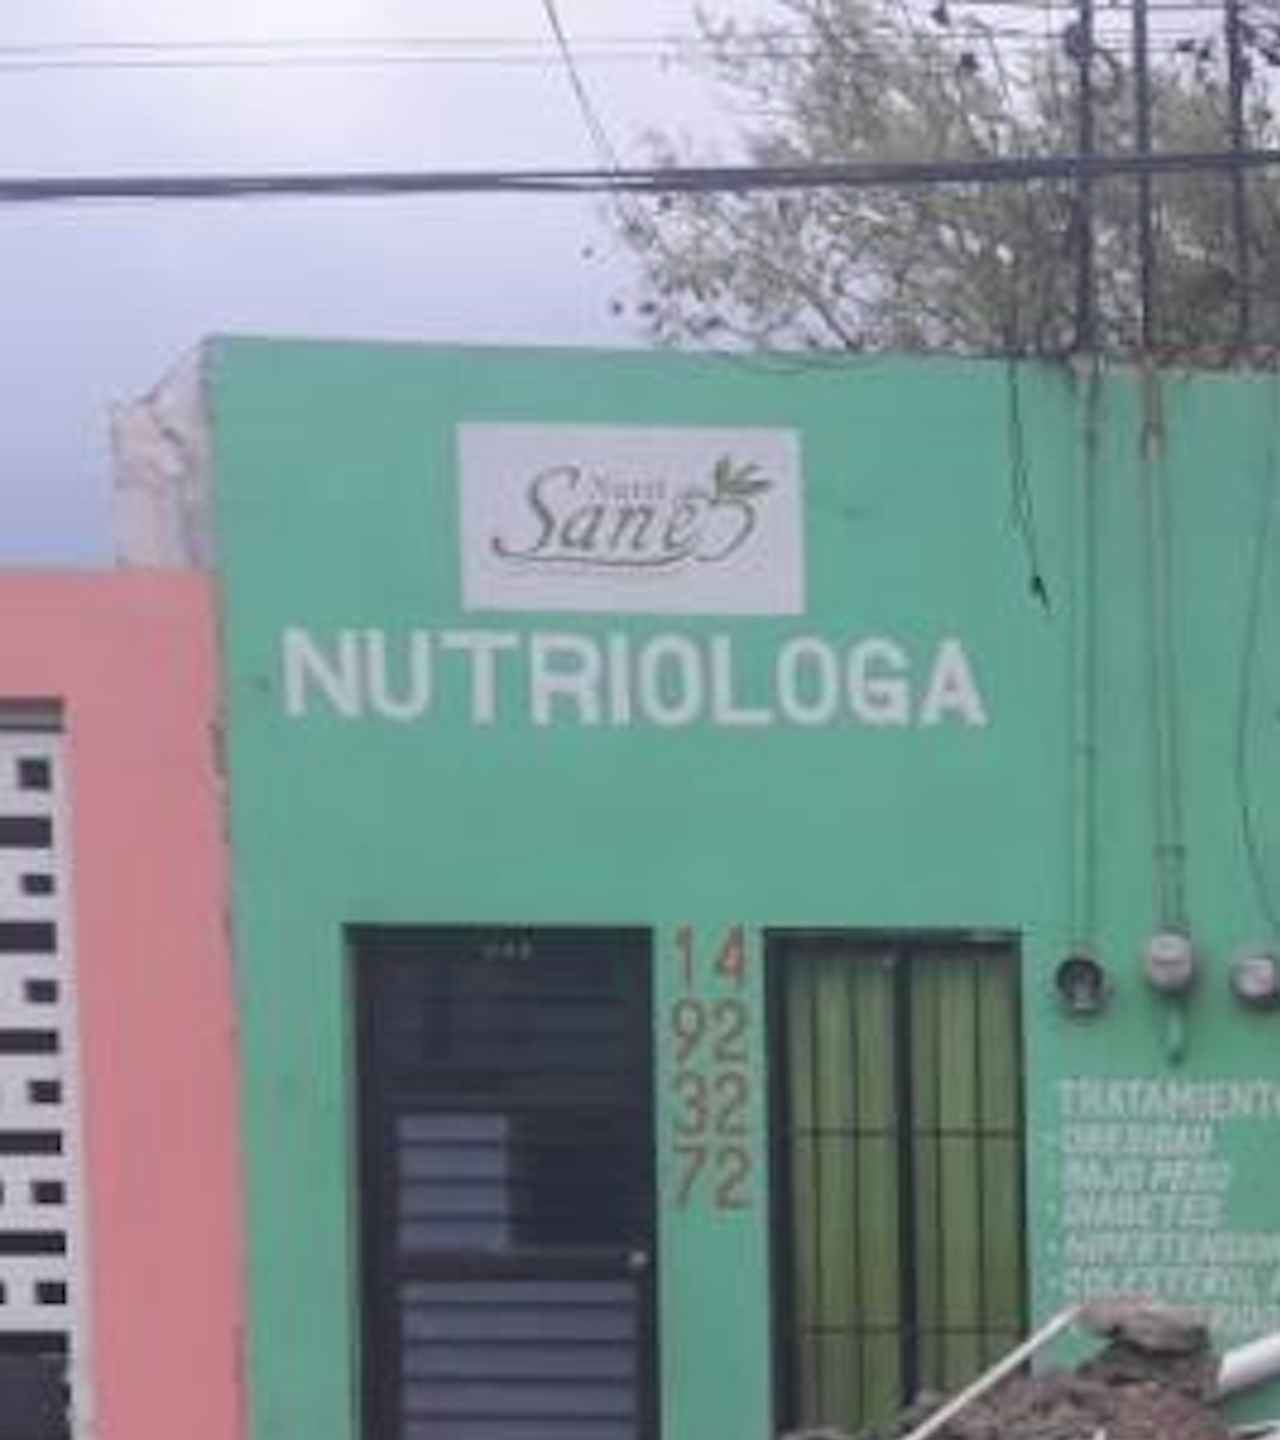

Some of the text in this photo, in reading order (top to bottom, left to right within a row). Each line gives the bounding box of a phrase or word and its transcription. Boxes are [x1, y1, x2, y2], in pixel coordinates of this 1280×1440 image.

[282, 626, 987, 729] NUTRIOLOGA
[674, 926, 746, 989] 14
[671, 998, 748, 1066] 92
[671, 1072, 749, 1136] 32
[671, 1145, 752, 1210] 72
